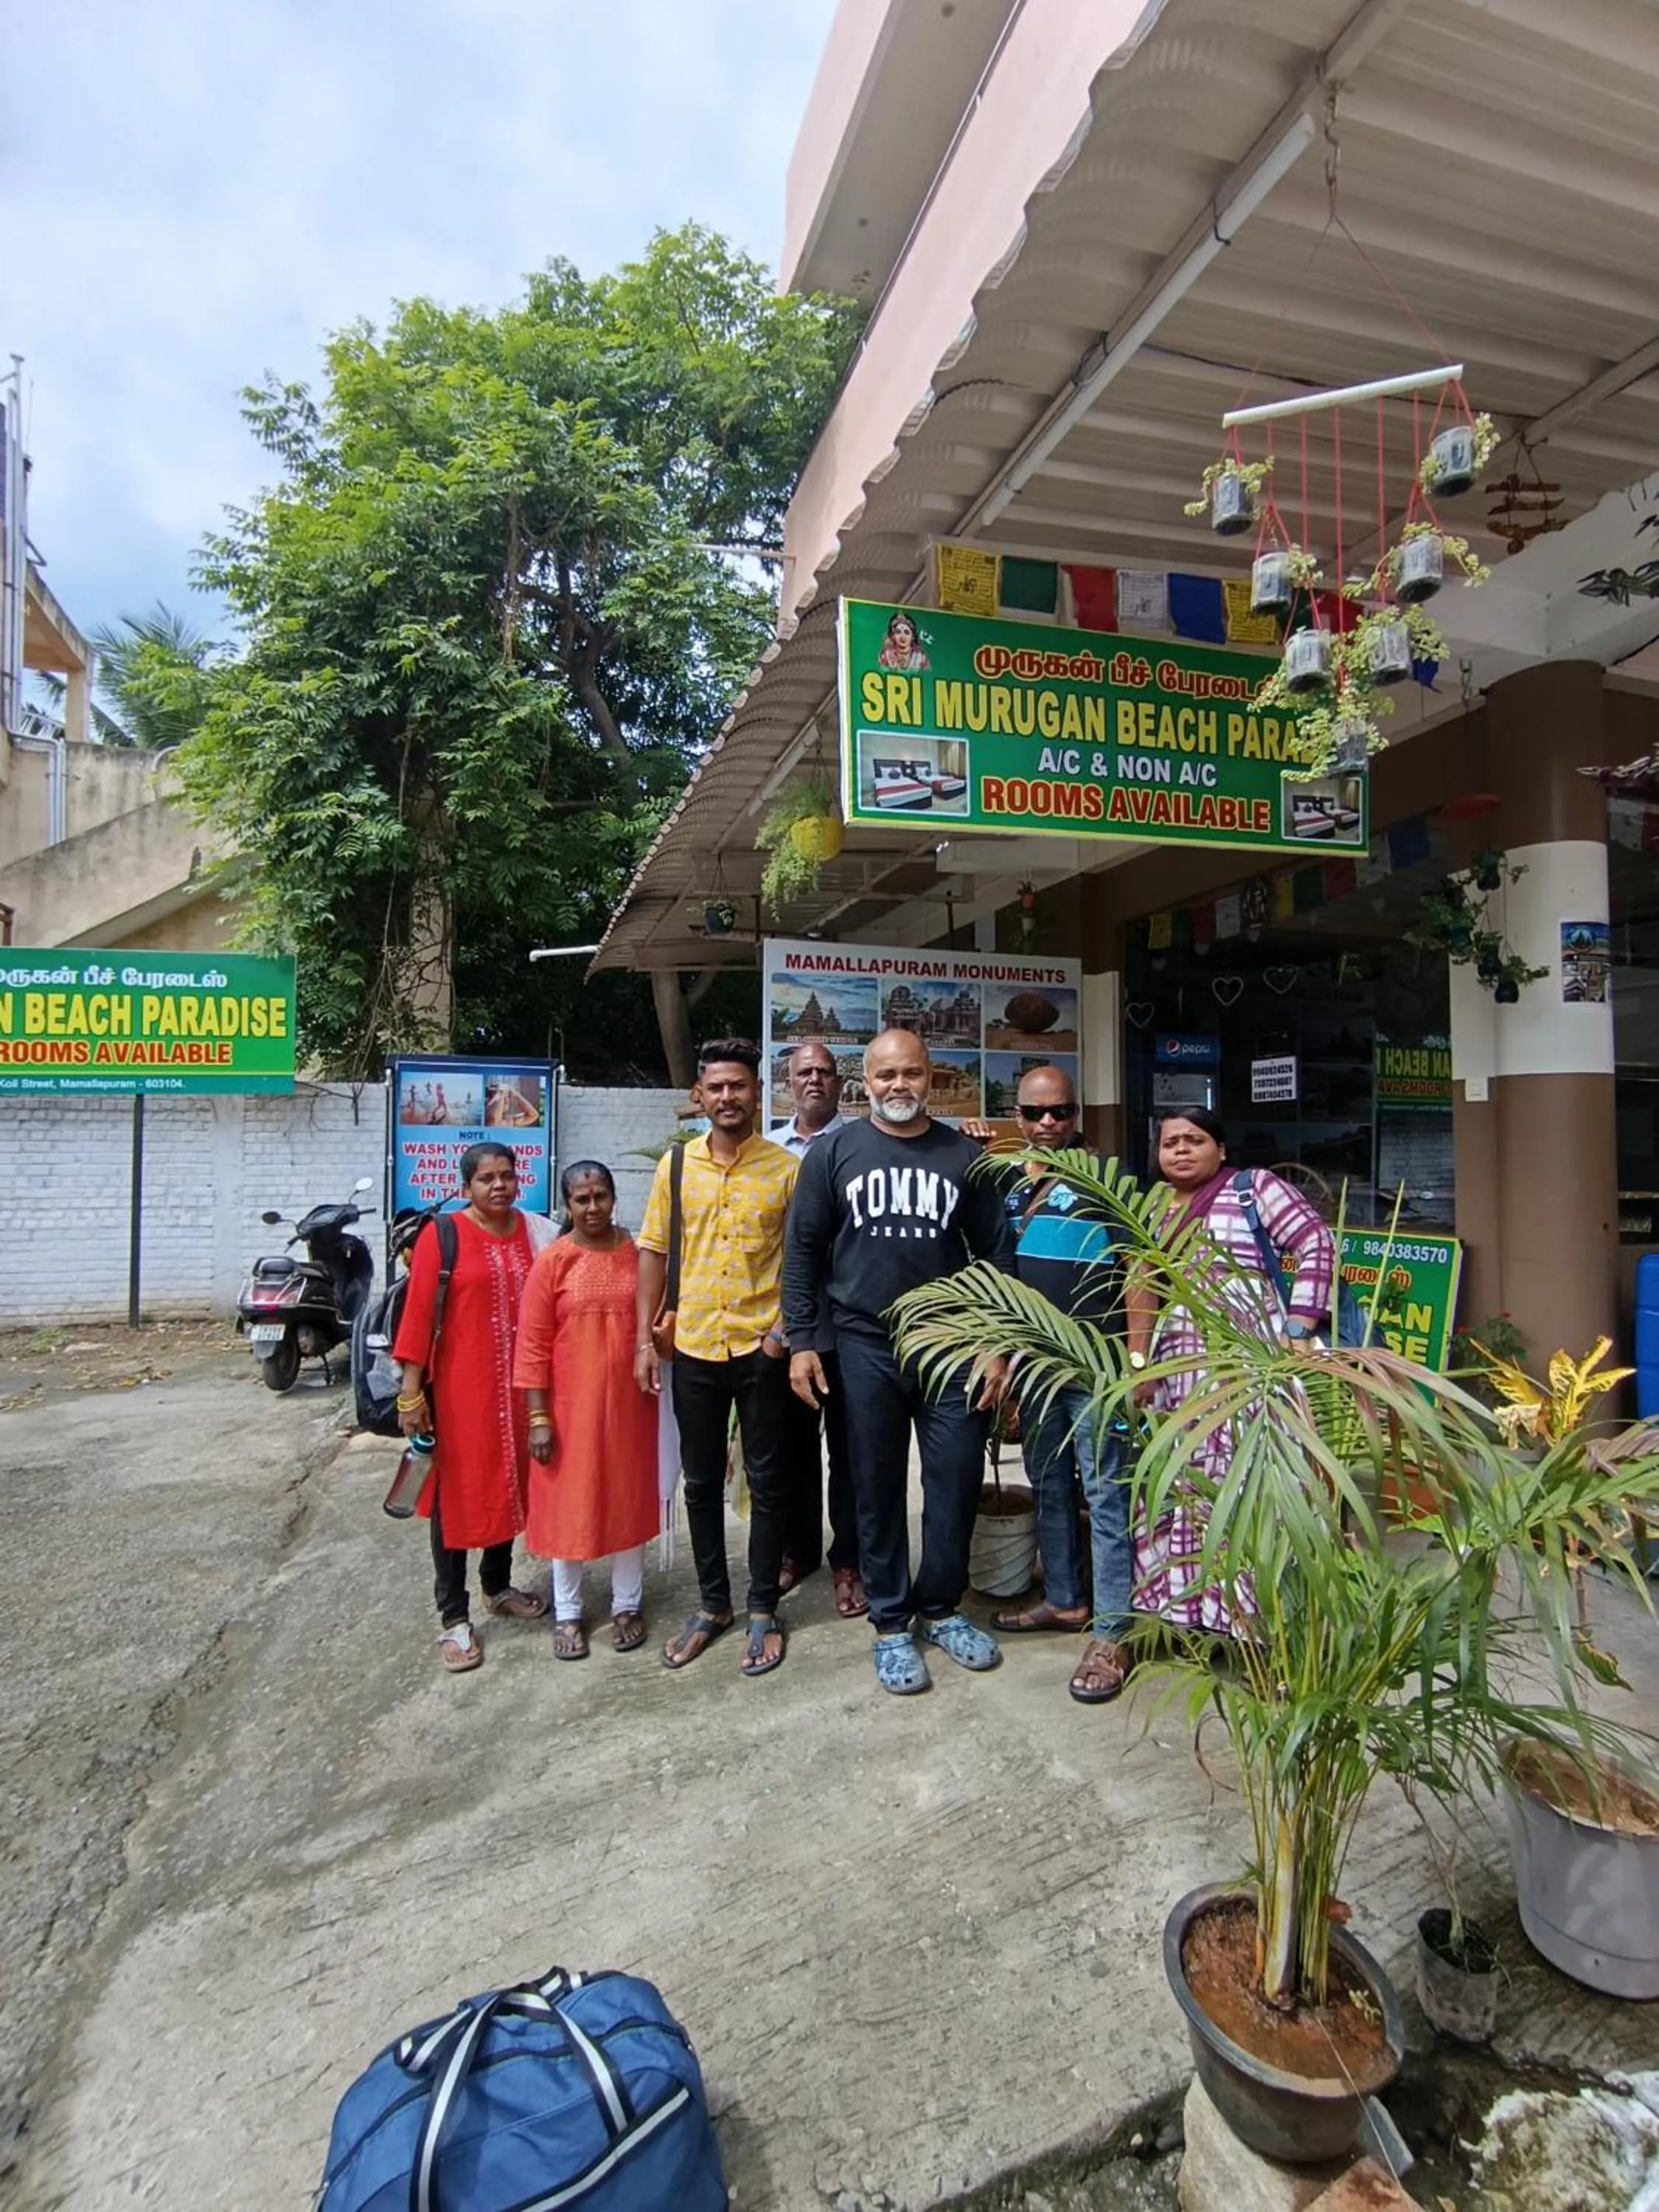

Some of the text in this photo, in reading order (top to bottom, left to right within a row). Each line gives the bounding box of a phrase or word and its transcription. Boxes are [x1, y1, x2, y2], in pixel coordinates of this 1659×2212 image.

[975, 645, 1105, 683] முருகன்
[1109, 651, 1152, 688] பீச்
[861, 672, 1315, 764] SRI MURUGAN BEACH PARA
[1038, 748, 1217, 787] A/C & NON A/C
[981, 776, 1270, 832] ROOMS AVAILABLE
[83, 964, 116, 986] பீச்
[121, 967, 228, 989] பேரடைஸ்
[785, 953, 1065, 984] MAMALLAPURAM MONUMENTS
[24, 992, 131, 1035] BEACH
[142, 995, 287, 1037] PARADISE
[0, 1040, 232, 1065] ROOMS AVAILABLE
[1182, 1044, 1210, 1055] pepsi
[459, 1130, 484, 1139] NOTE
[404, 1144, 446, 1155] WASH
[417, 1158, 448, 1169] AND
[411, 1173, 456, 1184] AFTER
[421, 1188, 436, 1198] IN
[846, 1167, 959, 1231] TOMMY
